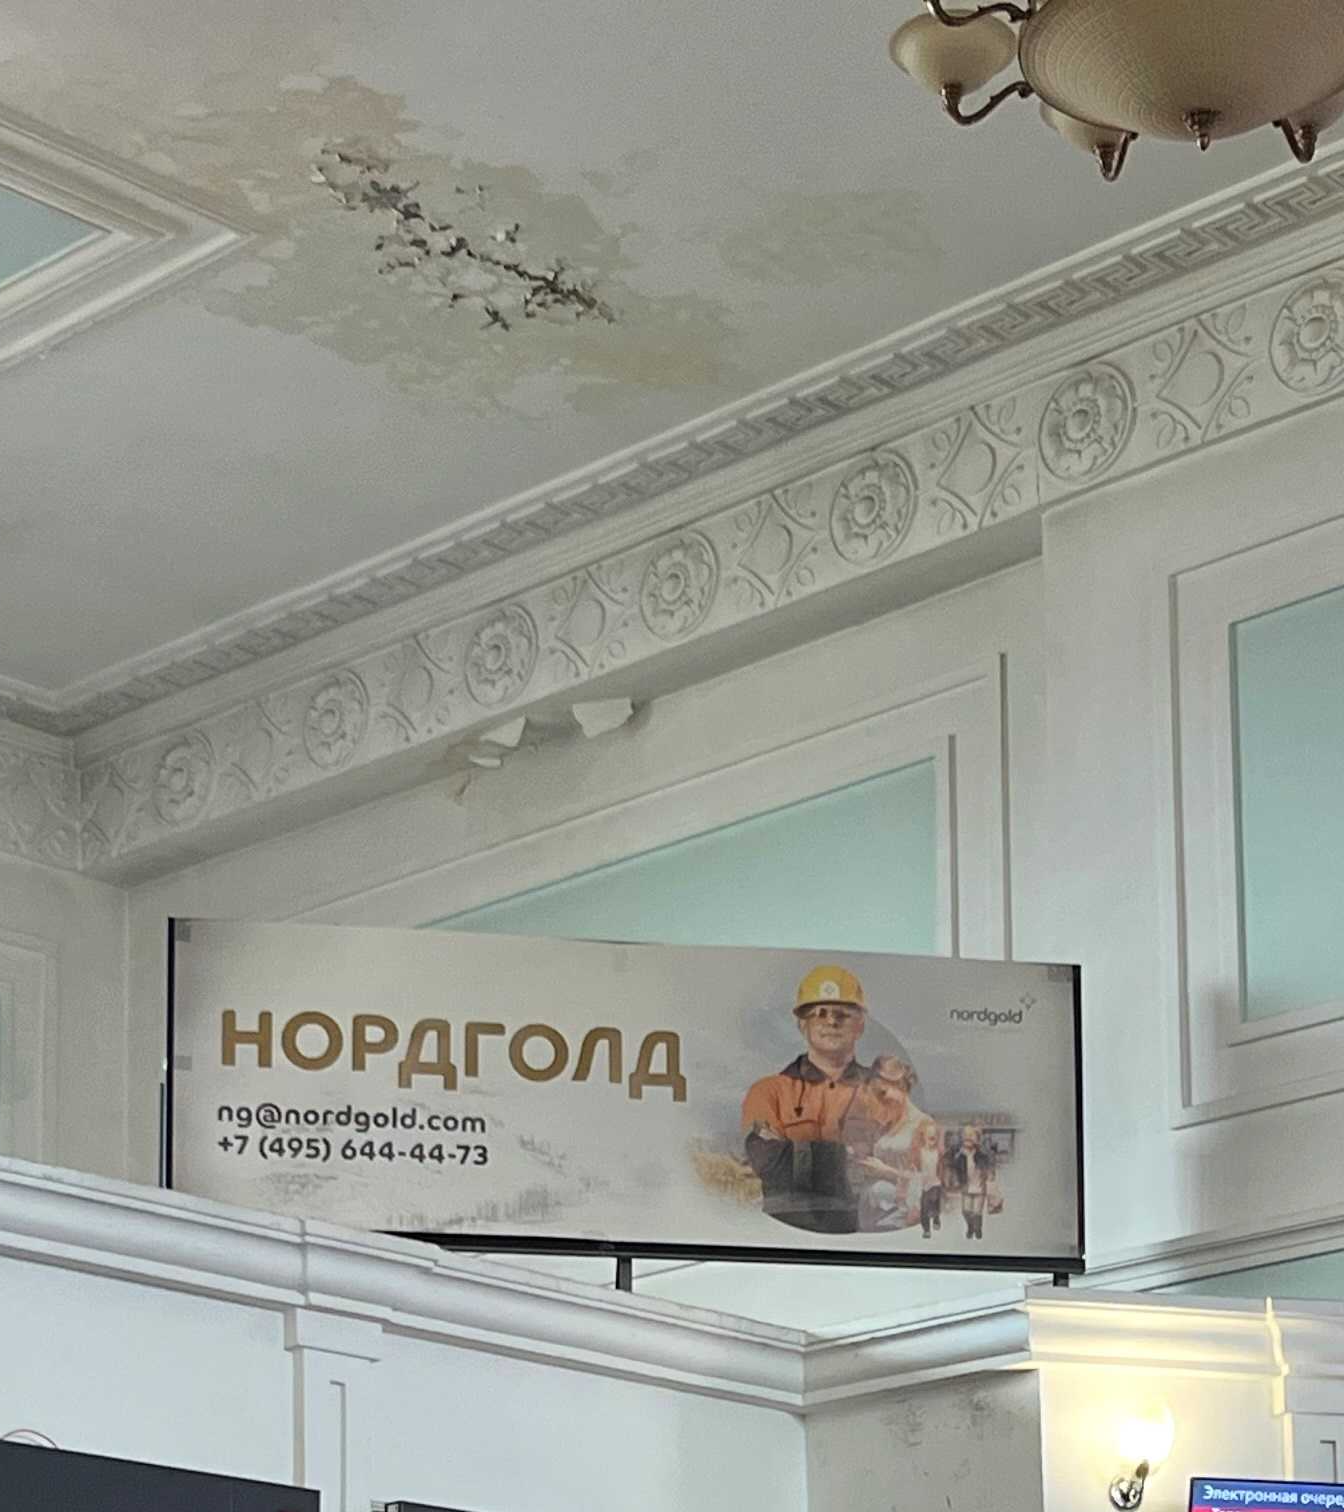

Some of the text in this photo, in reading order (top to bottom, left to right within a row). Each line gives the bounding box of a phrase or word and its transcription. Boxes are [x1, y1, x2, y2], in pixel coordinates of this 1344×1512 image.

[949, 1005, 1023, 1027] nordgold
[218, 1008, 688, 1104] НОРДГОЛД
[218, 1101, 487, 1135] ng@nordgold.com
[218, 1135, 490, 1167] +7 (495) 644-44-73
[1203, 1485, 1298, 1504] Электронная
